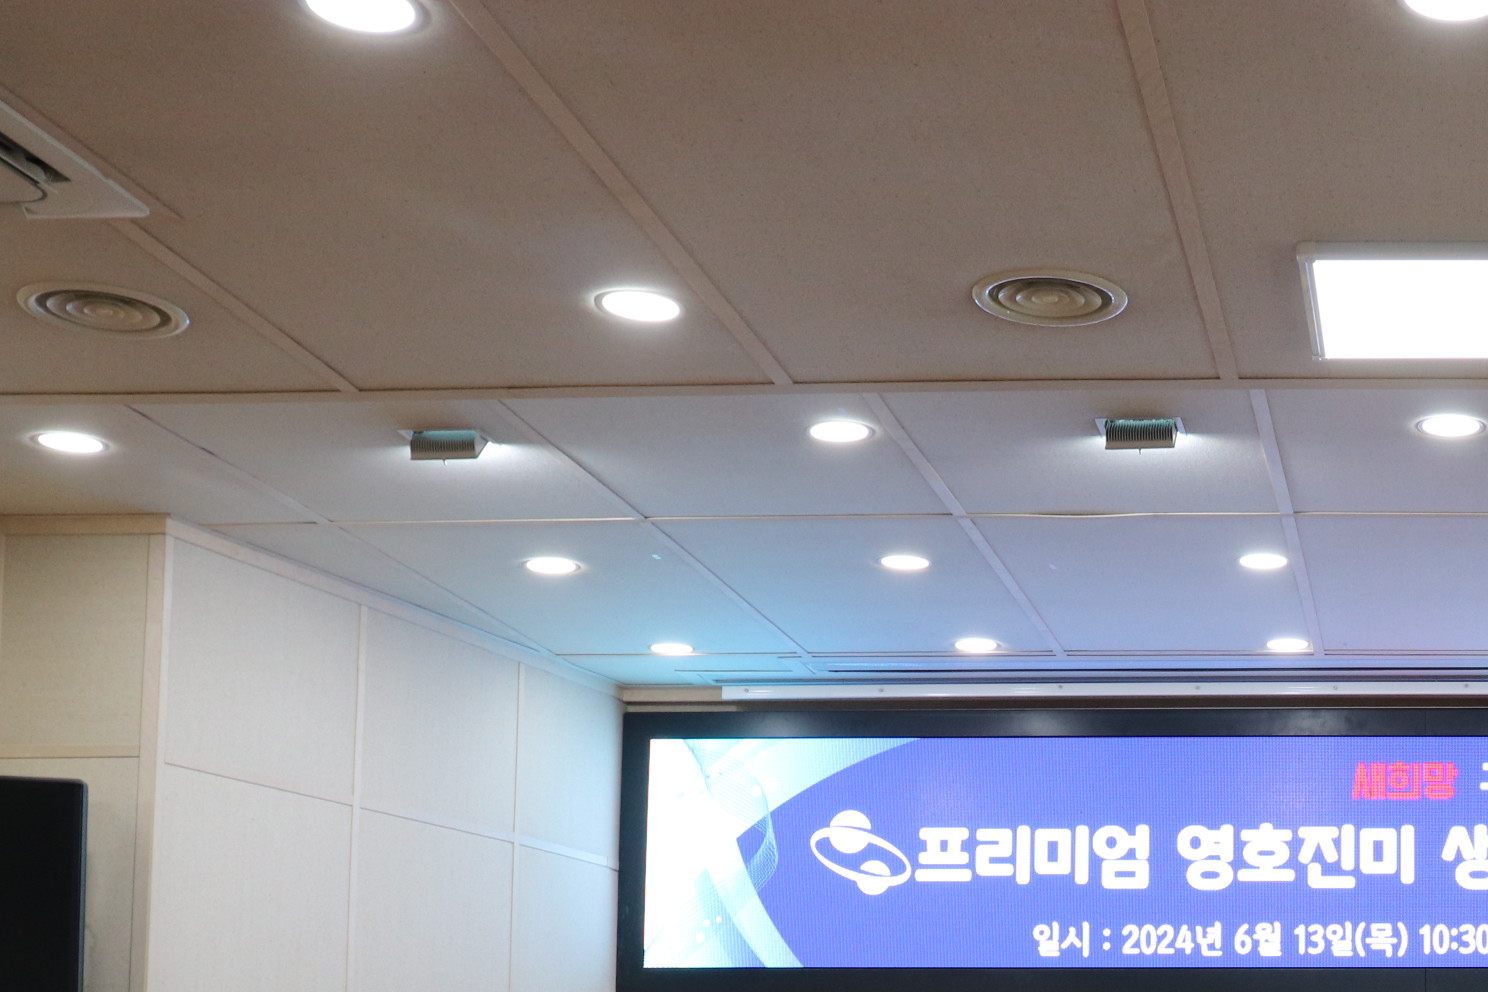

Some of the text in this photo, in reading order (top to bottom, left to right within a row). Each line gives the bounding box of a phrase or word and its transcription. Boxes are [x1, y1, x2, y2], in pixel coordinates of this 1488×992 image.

[914, 824, 1150, 890] 프리미엄
[1177, 824, 1416, 891] 영호진미
[1032, 922, 1091, 957] 일시
[1122, 922, 1224, 956] 2024년
[1234, 921, 1283, 957] 6월
[1294, 921, 1408, 957] 13일(목)
